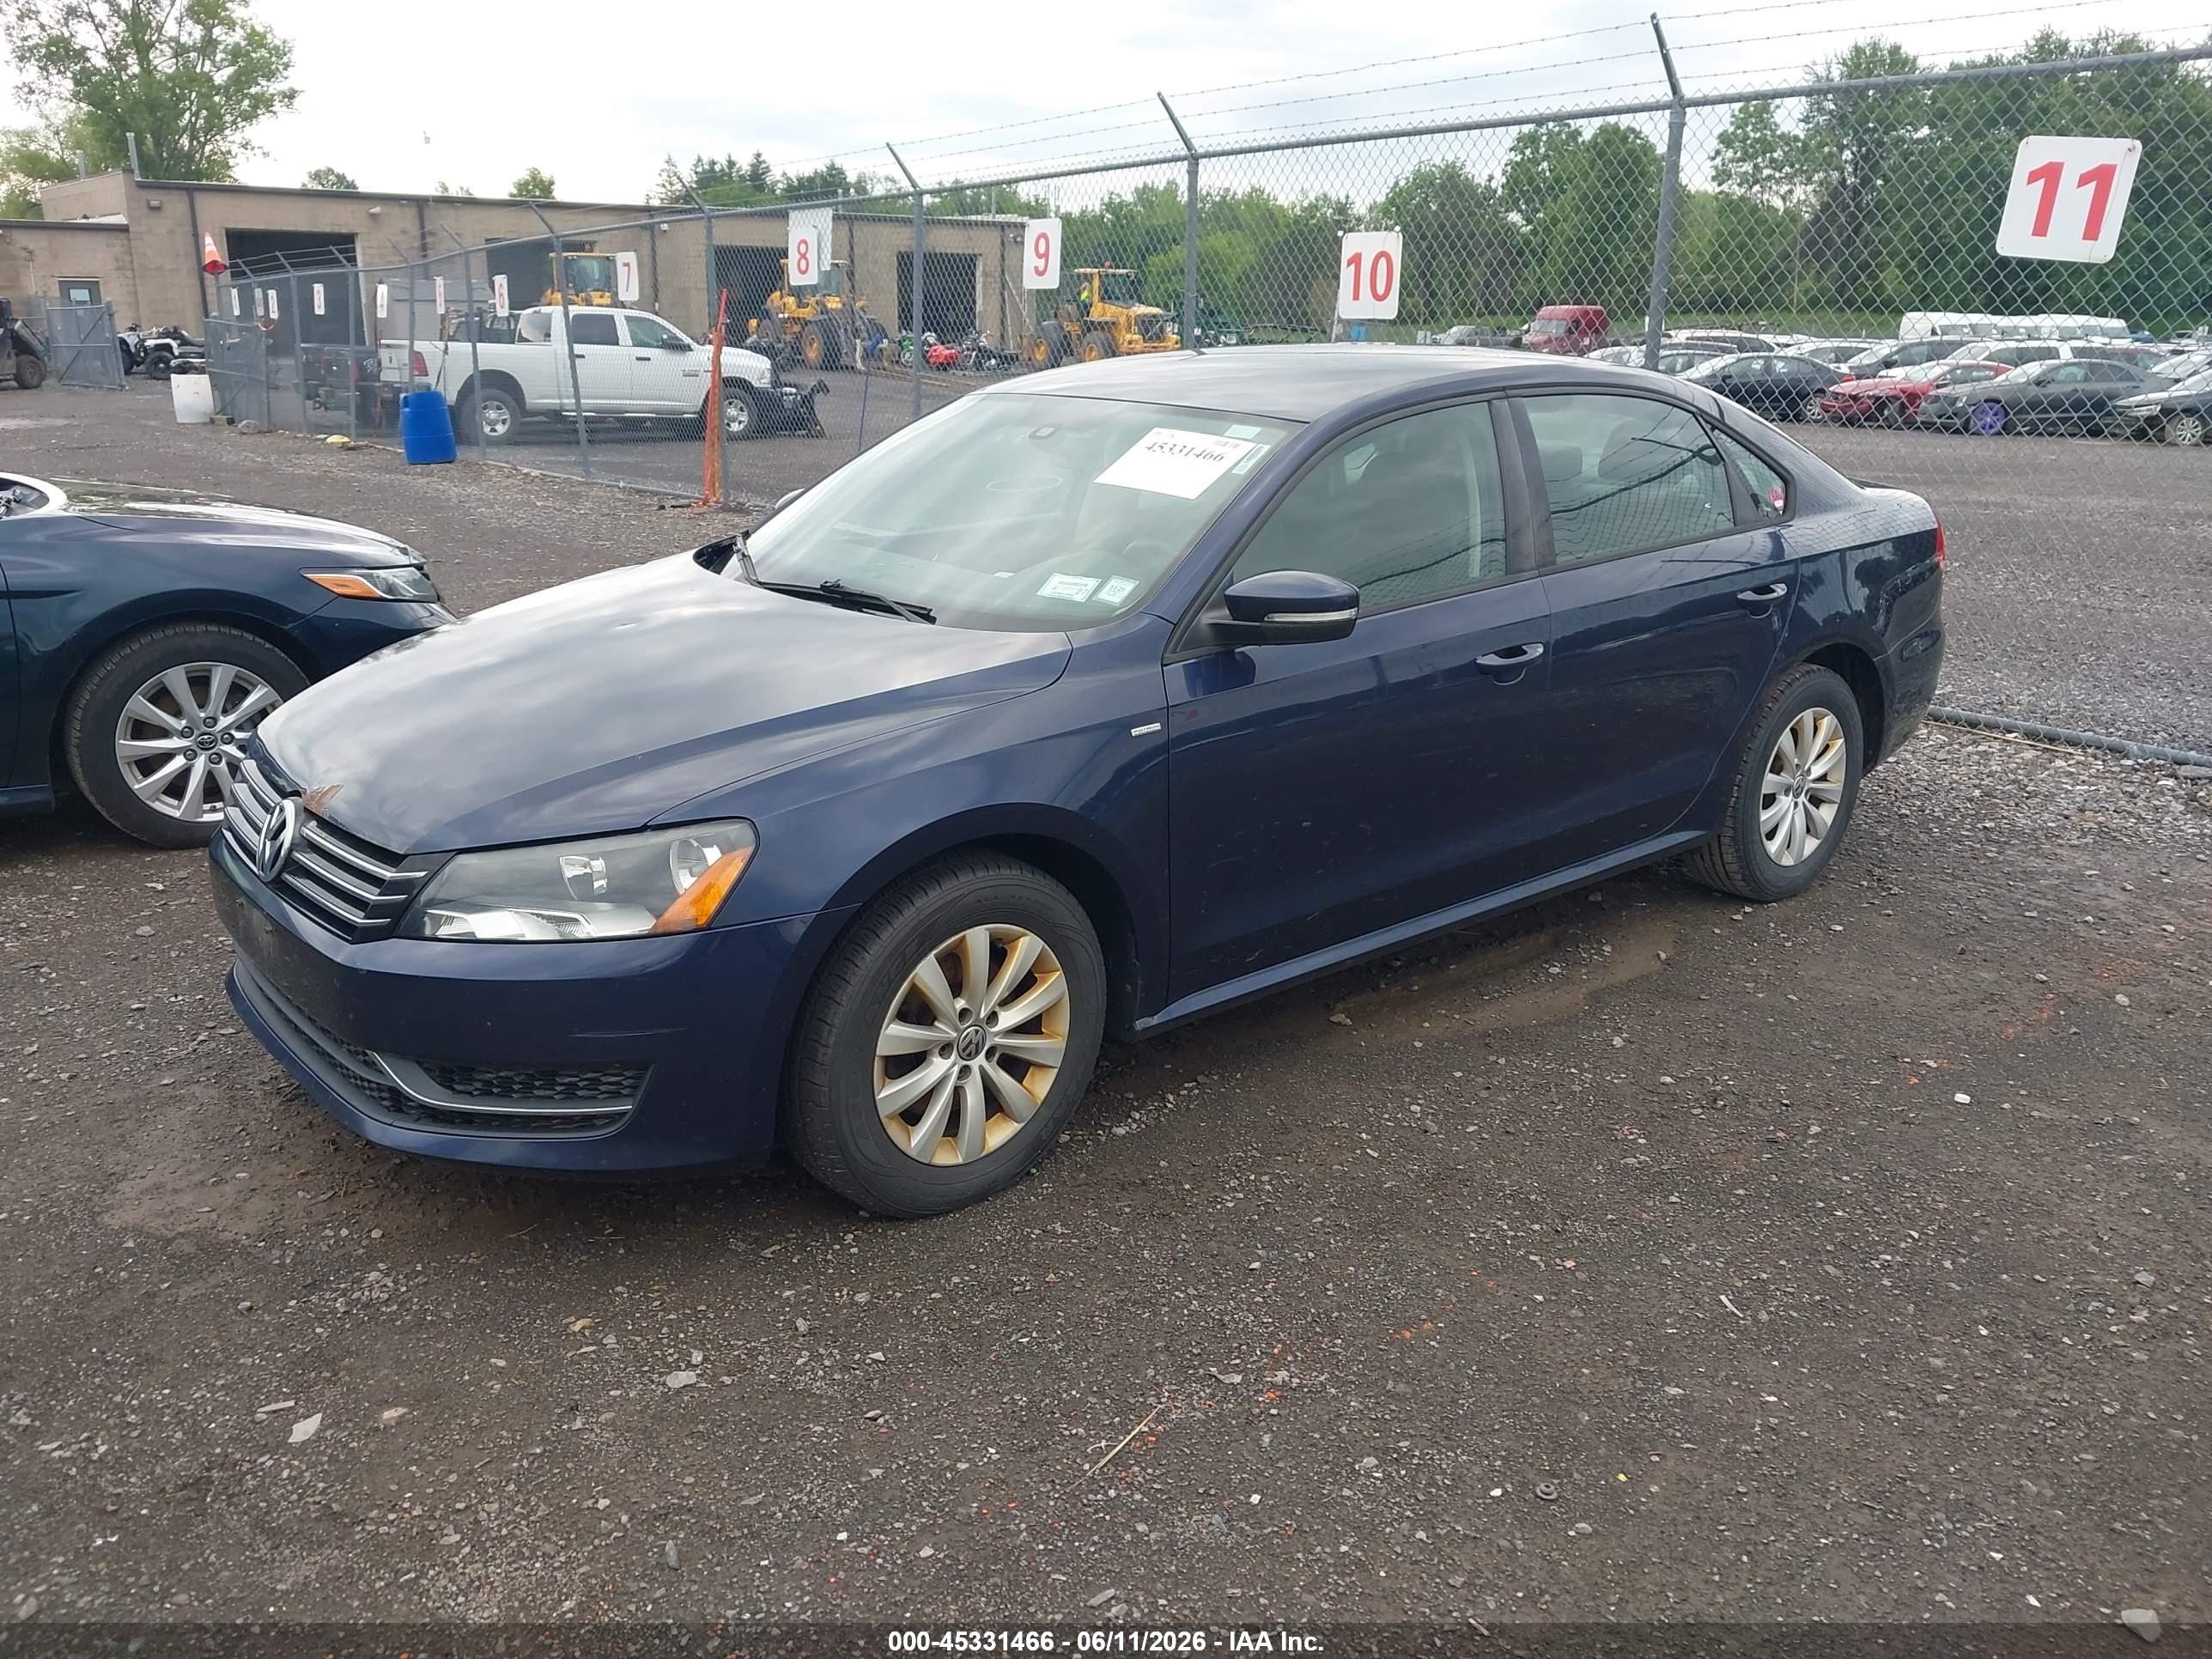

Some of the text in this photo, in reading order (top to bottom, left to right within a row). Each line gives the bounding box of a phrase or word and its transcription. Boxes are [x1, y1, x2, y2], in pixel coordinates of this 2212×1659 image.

[2027, 161, 2118, 241] 11
[797, 239, 810, 275] 8
[1033, 232, 1050, 276] 9
[622, 261, 632, 293] 7
[1346, 250, 1395, 302] 10
[497, 282, 505, 310] 6
[1145, 441, 1225, 463] 45331466
